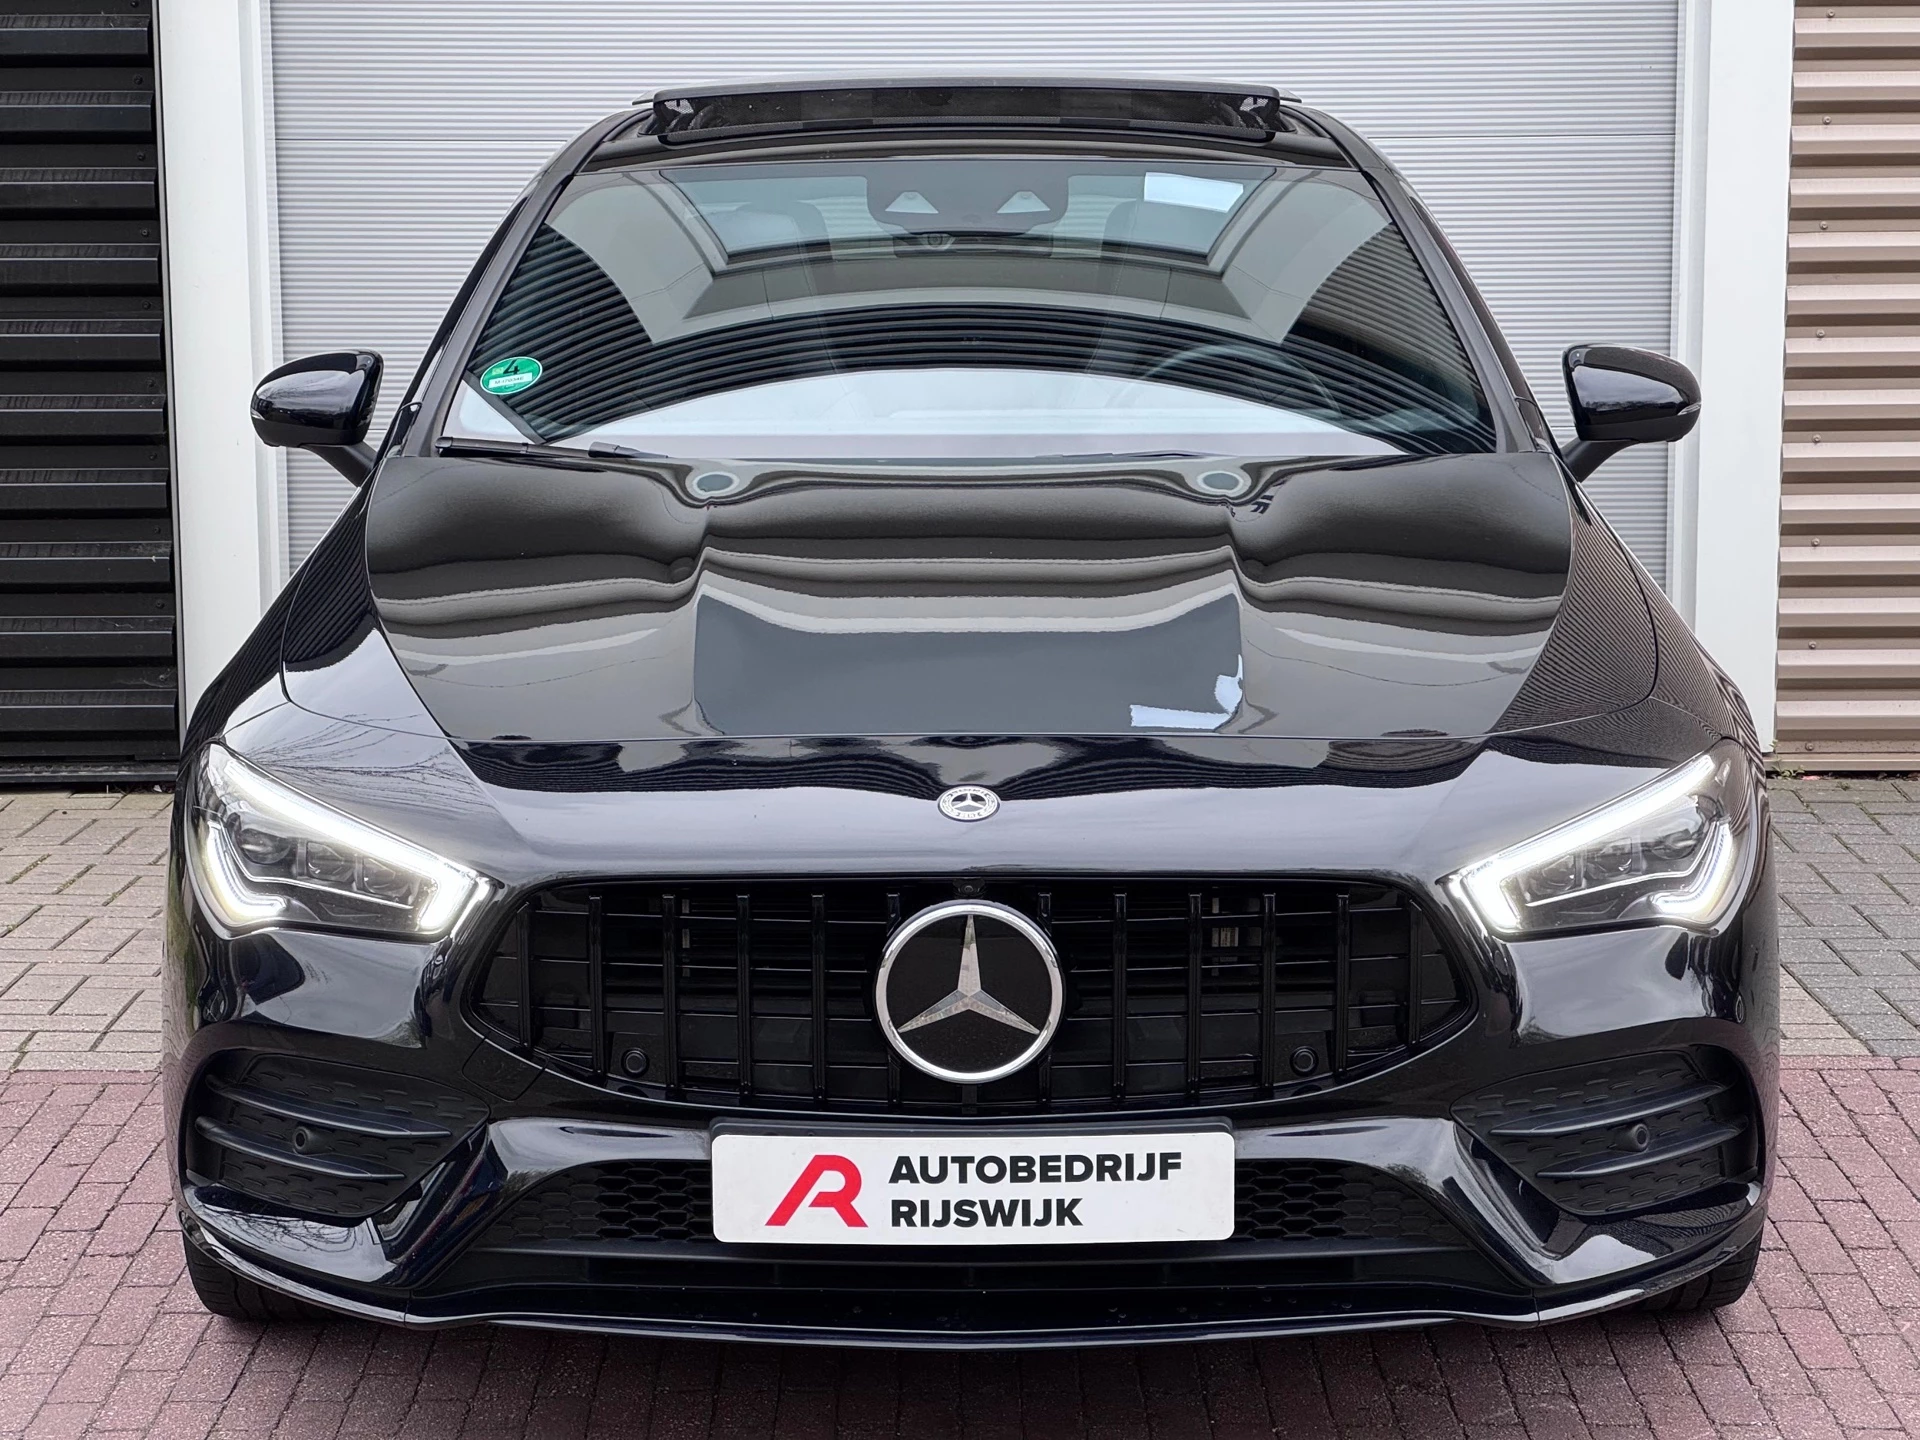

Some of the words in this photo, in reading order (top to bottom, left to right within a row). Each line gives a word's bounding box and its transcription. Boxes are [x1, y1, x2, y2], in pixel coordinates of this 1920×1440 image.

[503, 359, 520, 375] 4
[888, 1152, 1182, 1184] AUTOBEDRIJF
[891, 1198, 1083, 1228] RIJSWIJK
